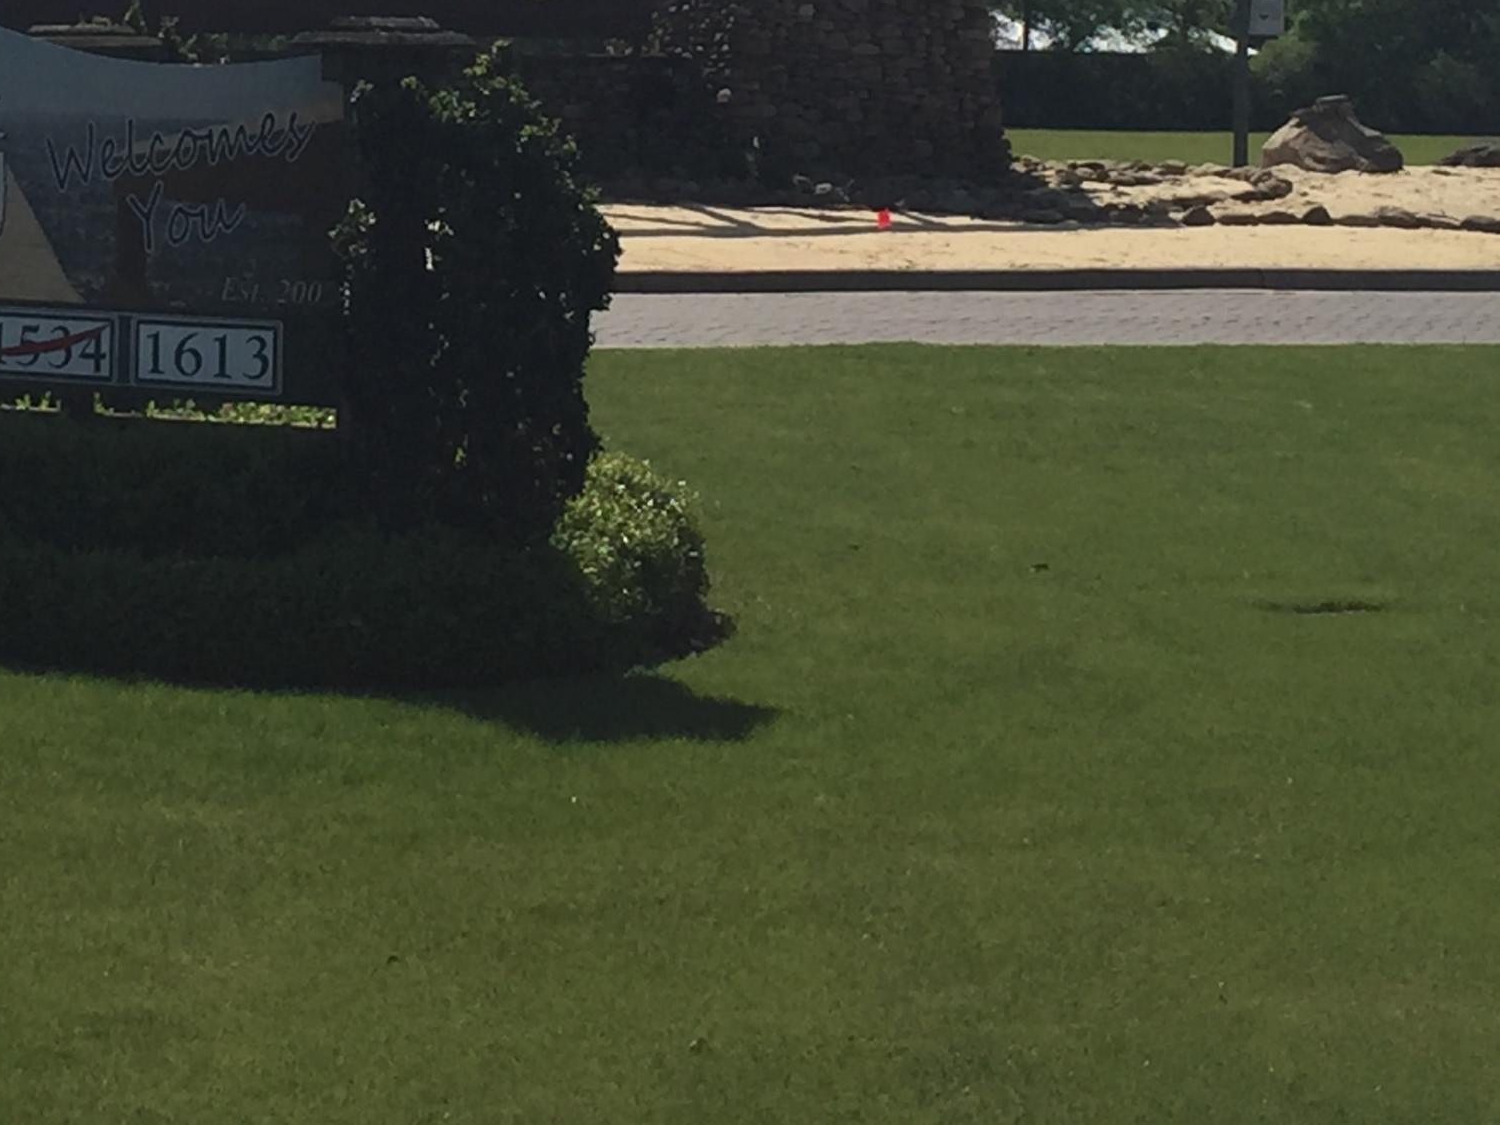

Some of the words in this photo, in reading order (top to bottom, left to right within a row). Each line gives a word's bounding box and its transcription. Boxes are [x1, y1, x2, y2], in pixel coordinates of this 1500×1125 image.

[46, 111, 316, 193] Welcomes
[126, 180, 246, 253] You
[147, 331, 270, 380] 1613
